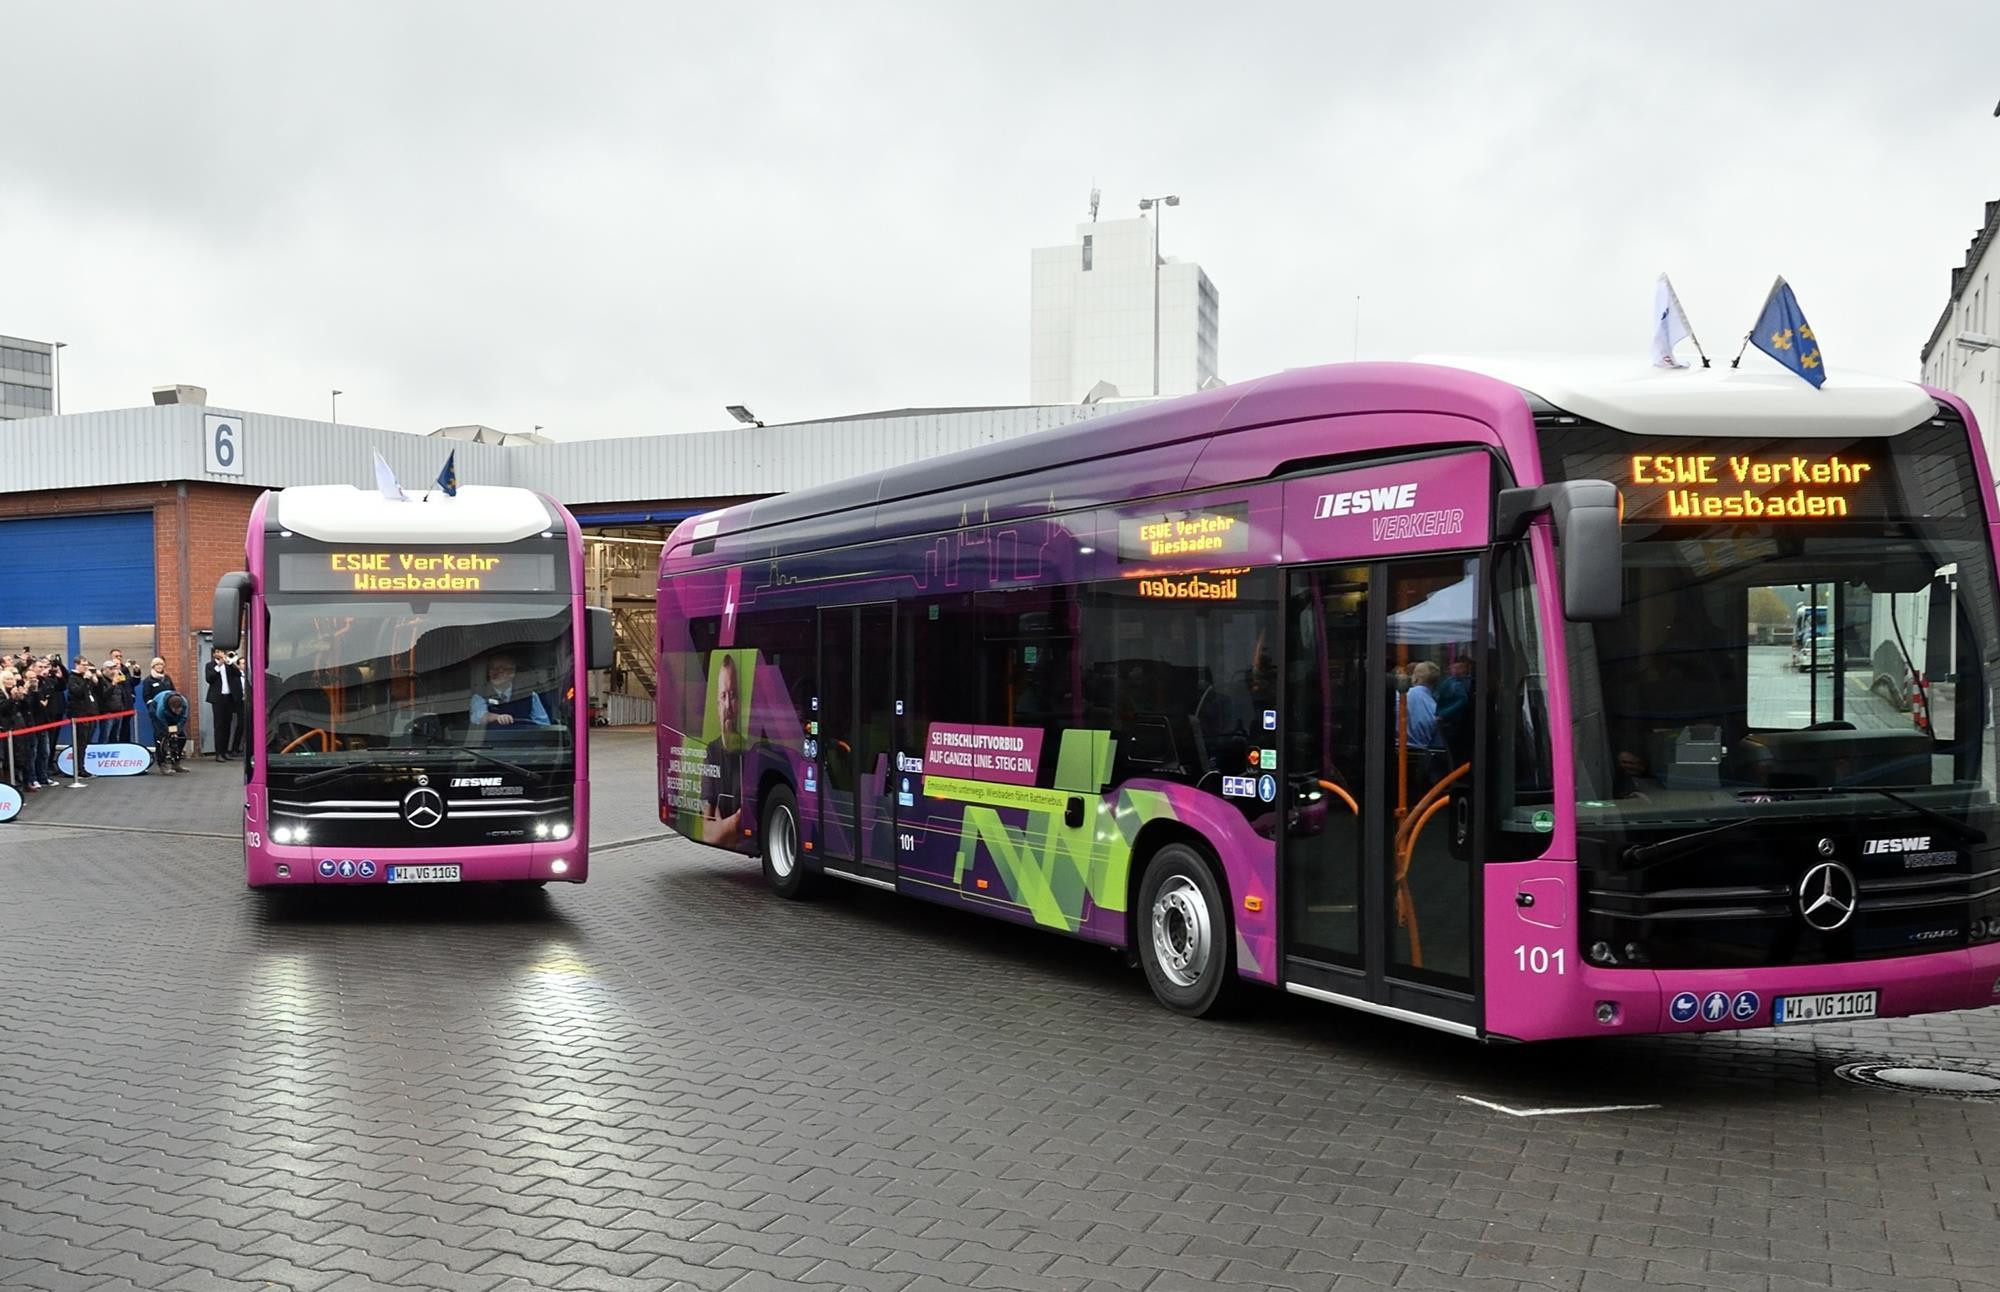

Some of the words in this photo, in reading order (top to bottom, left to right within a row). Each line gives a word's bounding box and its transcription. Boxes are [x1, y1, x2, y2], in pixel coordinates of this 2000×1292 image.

[215, 423, 234, 467] 6
[1632, 456, 1718, 484] ESWE
[1730, 456, 1871, 484] Verkehr
[1667, 489, 1848, 517] Wiesbaden
[1176, 516, 1235, 536] Verkehr
[1372, 508, 1464, 542] VERKEHR
[1151, 535, 1223, 555] Wiesbaden
[331, 553, 391, 571] ESWE
[399, 553, 500, 571] Verkehr
[354, 572, 480, 591] Wiesbaden
[931, 731, 943, 746] SEI
[943, 733, 1024, 752] FRISCHLUFTVORBILD
[97, 759, 144, 768] VERKEHR
[929, 750, 943, 764] AUF
[944, 751, 973, 768] GANZER
[974, 754, 995, 769] LINIE.
[995, 756, 1017, 772] STEIG
[1017, 758, 1034, 774] EIN.
[900, 834, 915, 851] 101
[396, 868, 408, 880] WI
[416, 867, 430, 879] VG
[431, 866, 458, 879] 1103
[1513, 945, 1566, 976] 101
[1786, 999, 1803, 1018] WI
[1815, 996, 1834, 1017] VG
[1836, 993, 1872, 1015] 1101
